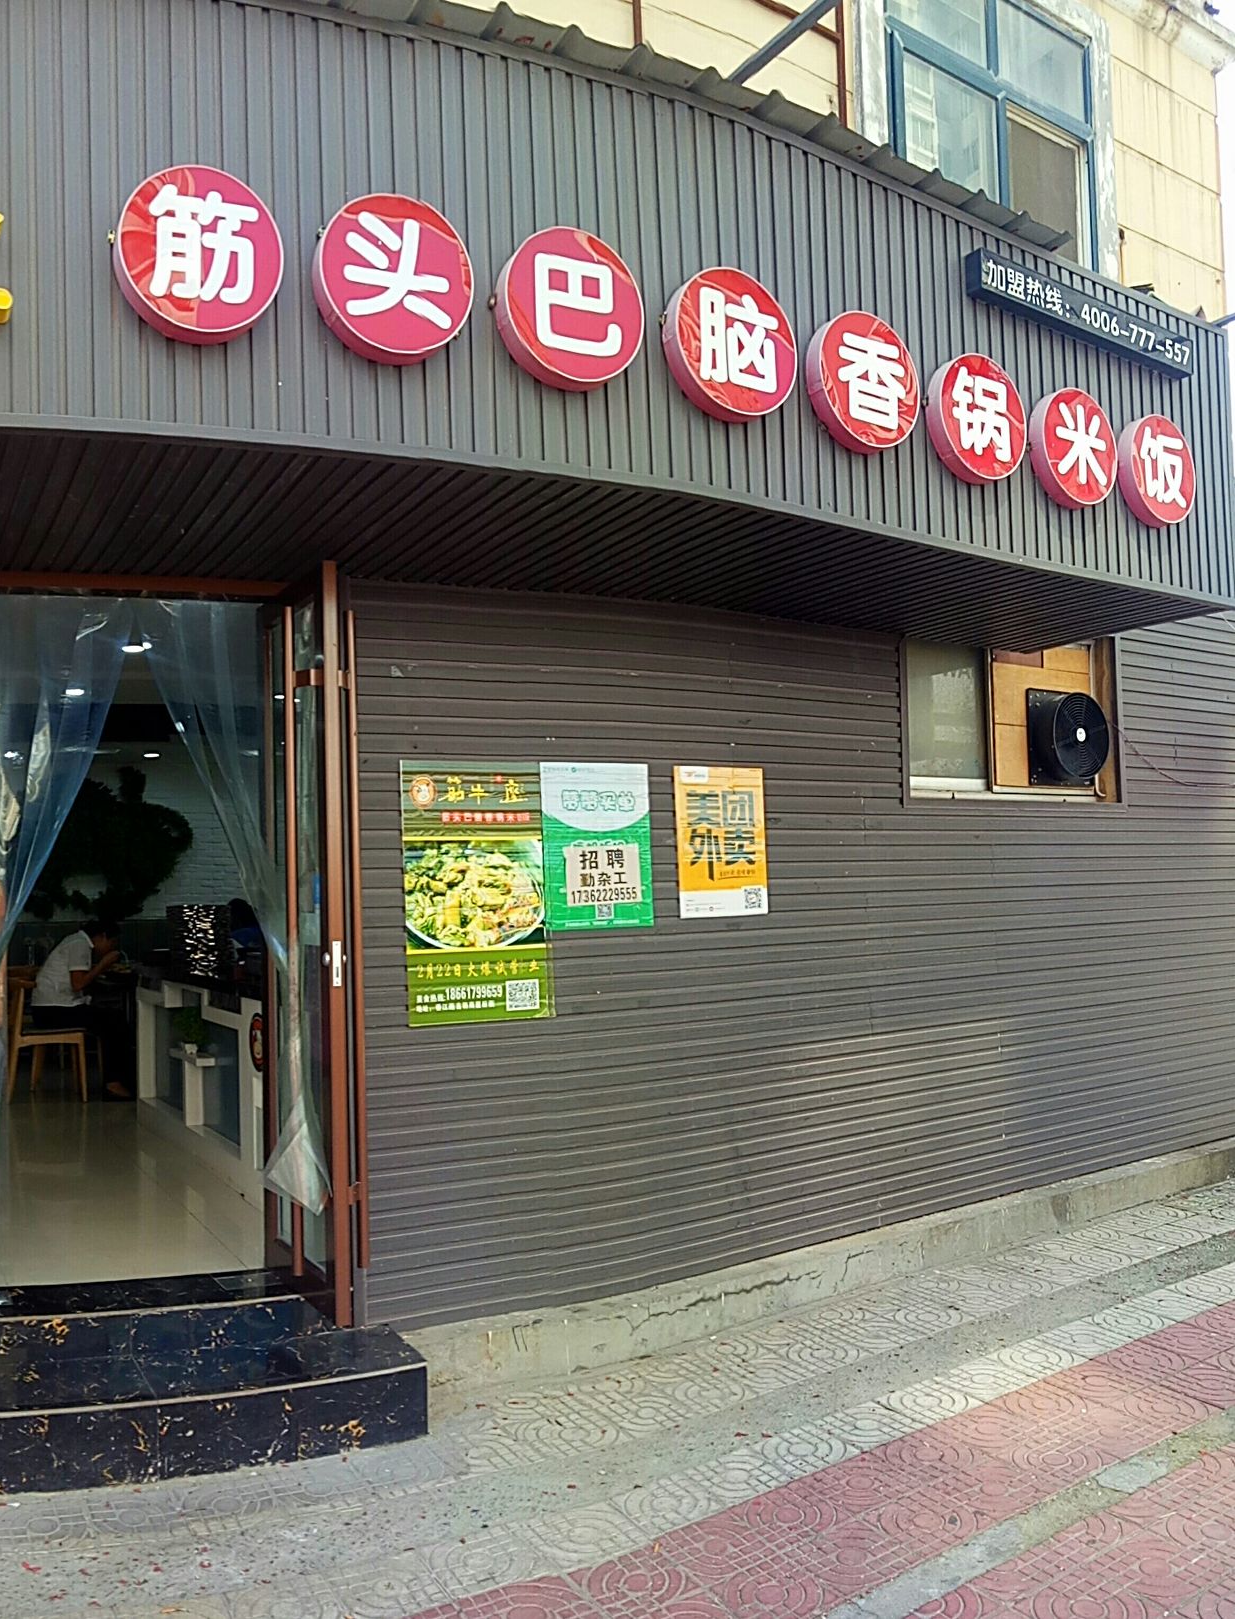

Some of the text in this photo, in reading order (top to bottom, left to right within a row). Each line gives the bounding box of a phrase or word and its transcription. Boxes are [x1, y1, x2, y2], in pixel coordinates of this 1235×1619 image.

[148, 184, 1188, 510] 筋头巴脑香锅米饭
[686, 789, 755, 828] 美团
[579, 848, 625, 870] 招聘
[688, 825, 756, 882] 外卖
[579, 871, 627, 888] 勤杂工
[571, 886, 638, 904] 17362229555
